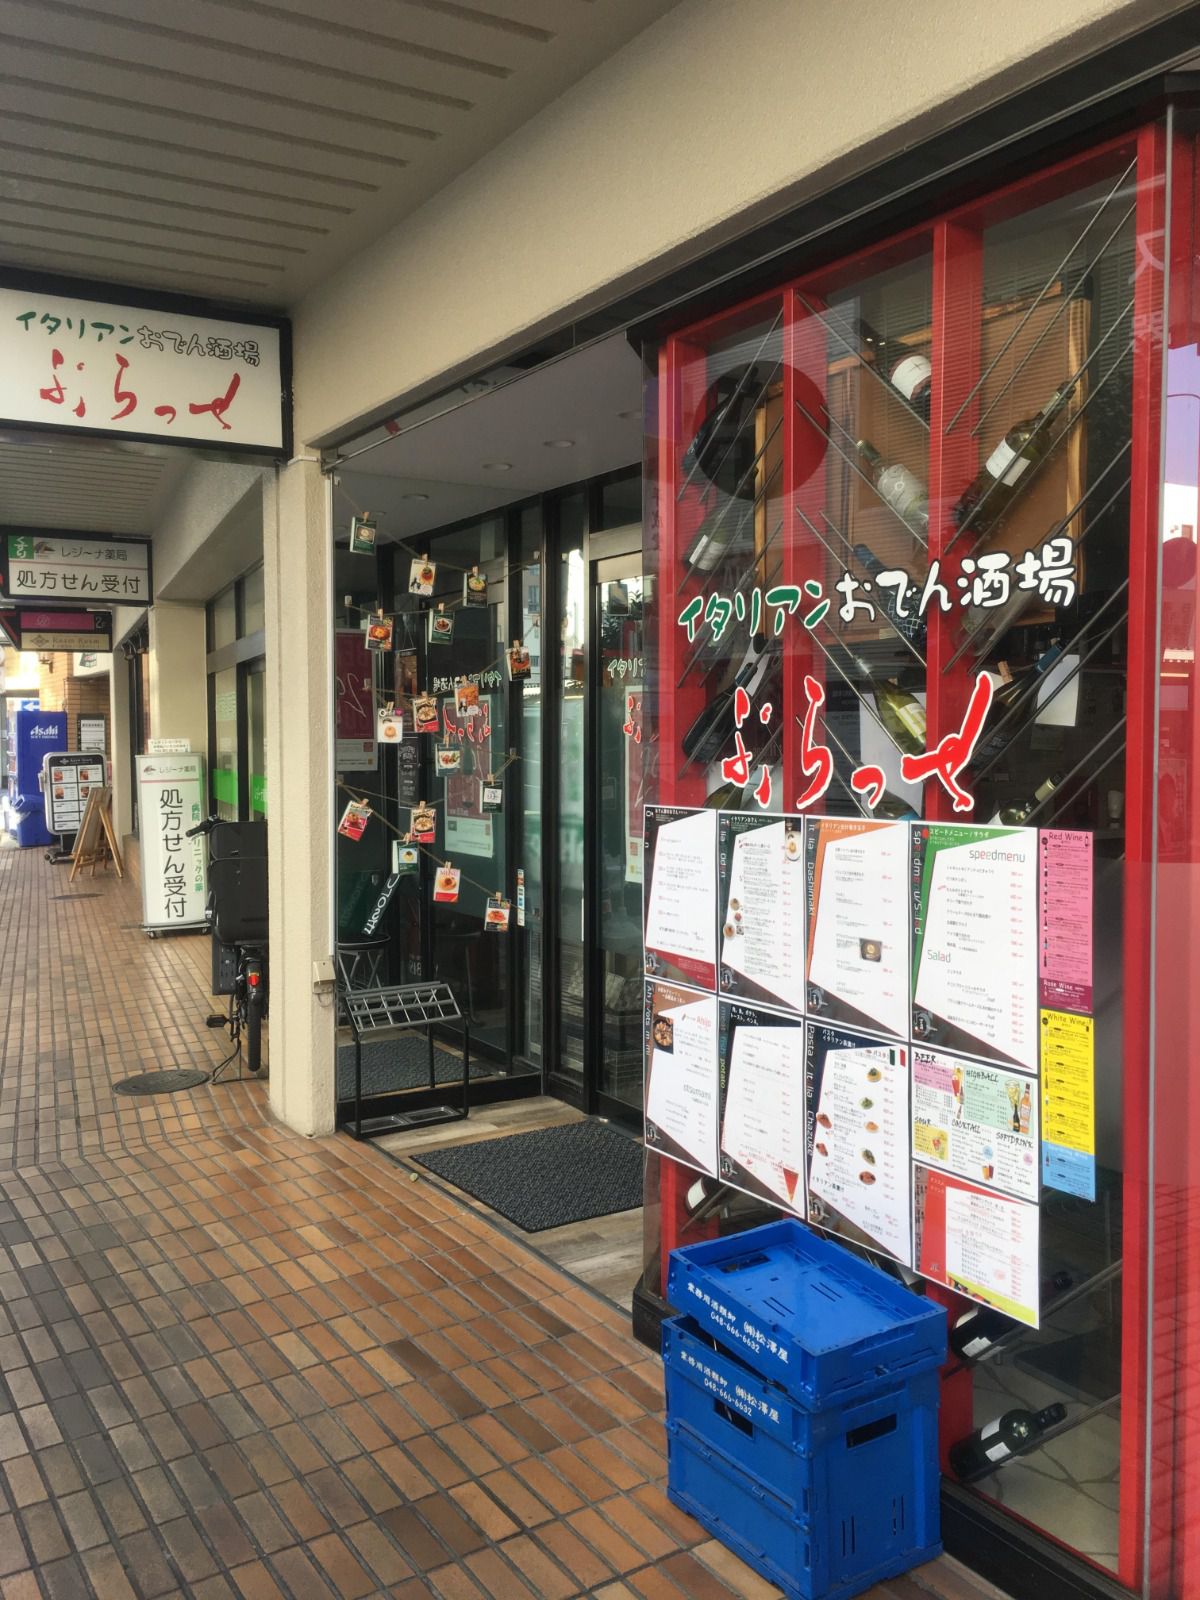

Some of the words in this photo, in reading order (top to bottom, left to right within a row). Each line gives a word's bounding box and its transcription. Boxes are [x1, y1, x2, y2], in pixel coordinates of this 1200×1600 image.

[16, 311, 260, 367] イタリアンおでん酒場
[14, 536, 27, 558] くすり
[61, 546, 128, 561] レジーナ薬局
[17, 570, 141, 594] 処方せん受付
[678, 537, 1077, 643] イタリアンおでん酒場
[30, 725, 58, 736] Asahi
[1049, 832, 1062, 840] Red
[1065, 833, 1082, 841] Wine
[160, 789, 187, 919] 処方せん受付
[969, 849, 1026, 863] speedmenu
[927, 949, 951, 963] Salad
[807, 1025, 815, 1056] Pasta
[914, 1051, 936, 1064] BEER
[719, 1058, 727, 1089] potato
